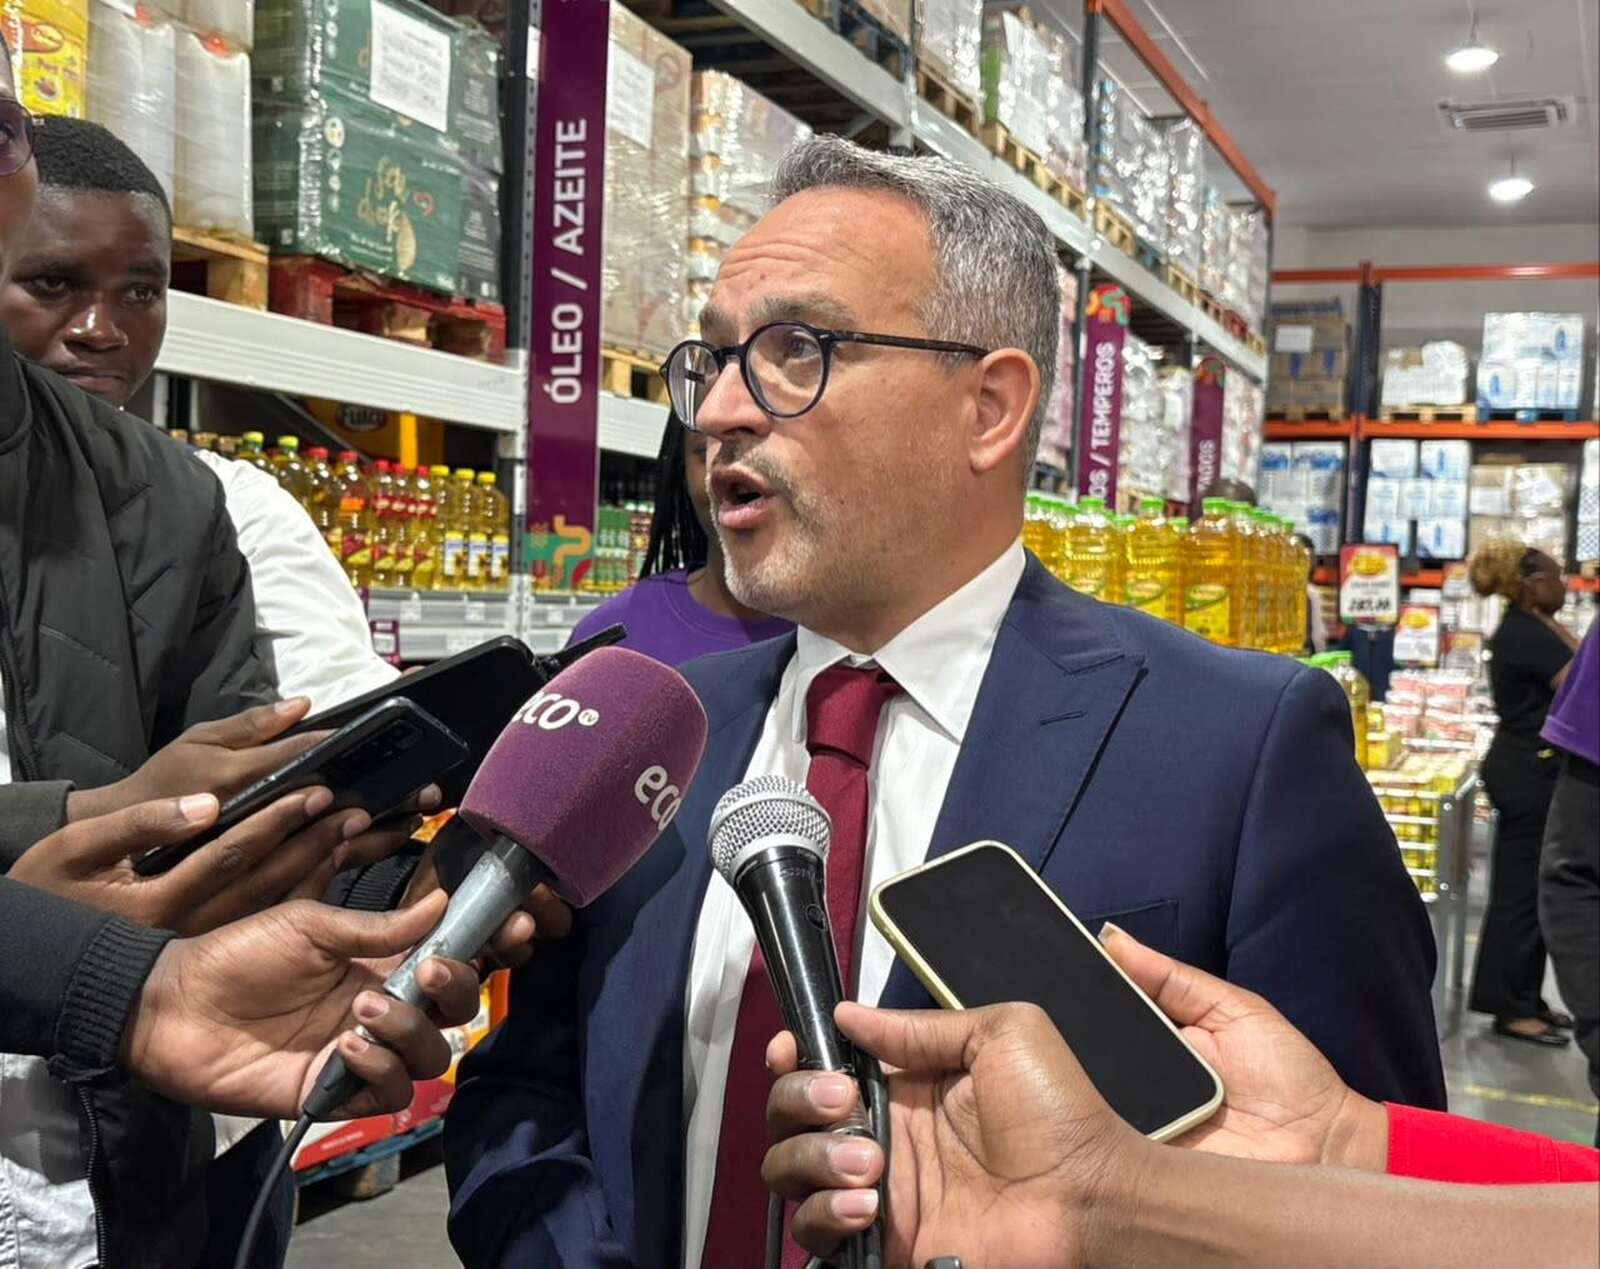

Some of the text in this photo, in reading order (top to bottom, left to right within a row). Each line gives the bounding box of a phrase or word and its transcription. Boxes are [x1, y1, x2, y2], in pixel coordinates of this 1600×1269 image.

[543, 118, 588, 404] ÓLEO / AZEITE
[1091, 341, 1116, 450] TEMPEROS
[634, 765, 681, 831] eco
